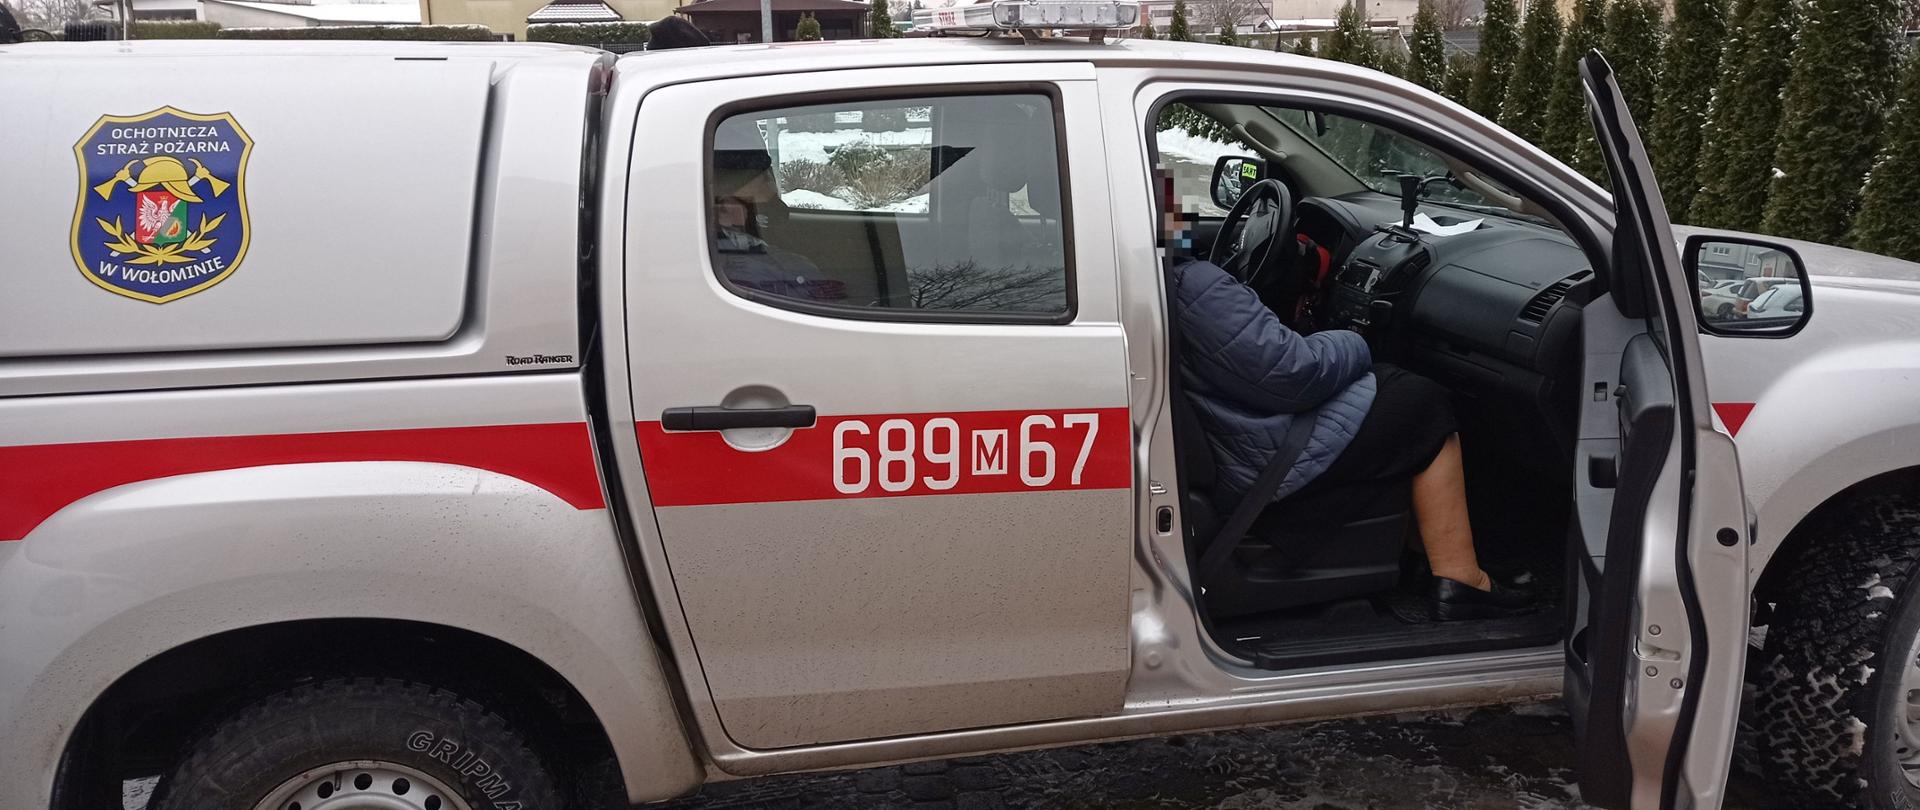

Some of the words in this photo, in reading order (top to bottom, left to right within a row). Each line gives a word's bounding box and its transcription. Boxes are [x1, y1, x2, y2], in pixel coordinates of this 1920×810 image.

[111, 126, 218, 139] OCHOTNICZA
[97, 140, 149, 155] STRAŻ
[154, 139, 230, 154] POŻARNA
[100, 260, 118, 277] W
[122, 256, 225, 284] WOŁOMINIE
[505, 355, 533, 366] ROAD
[534, 354, 573, 364] RANGER
[833, 416, 960, 494] 689
[975, 432, 1005, 473] M
[1019, 413, 1099, 487] 67
